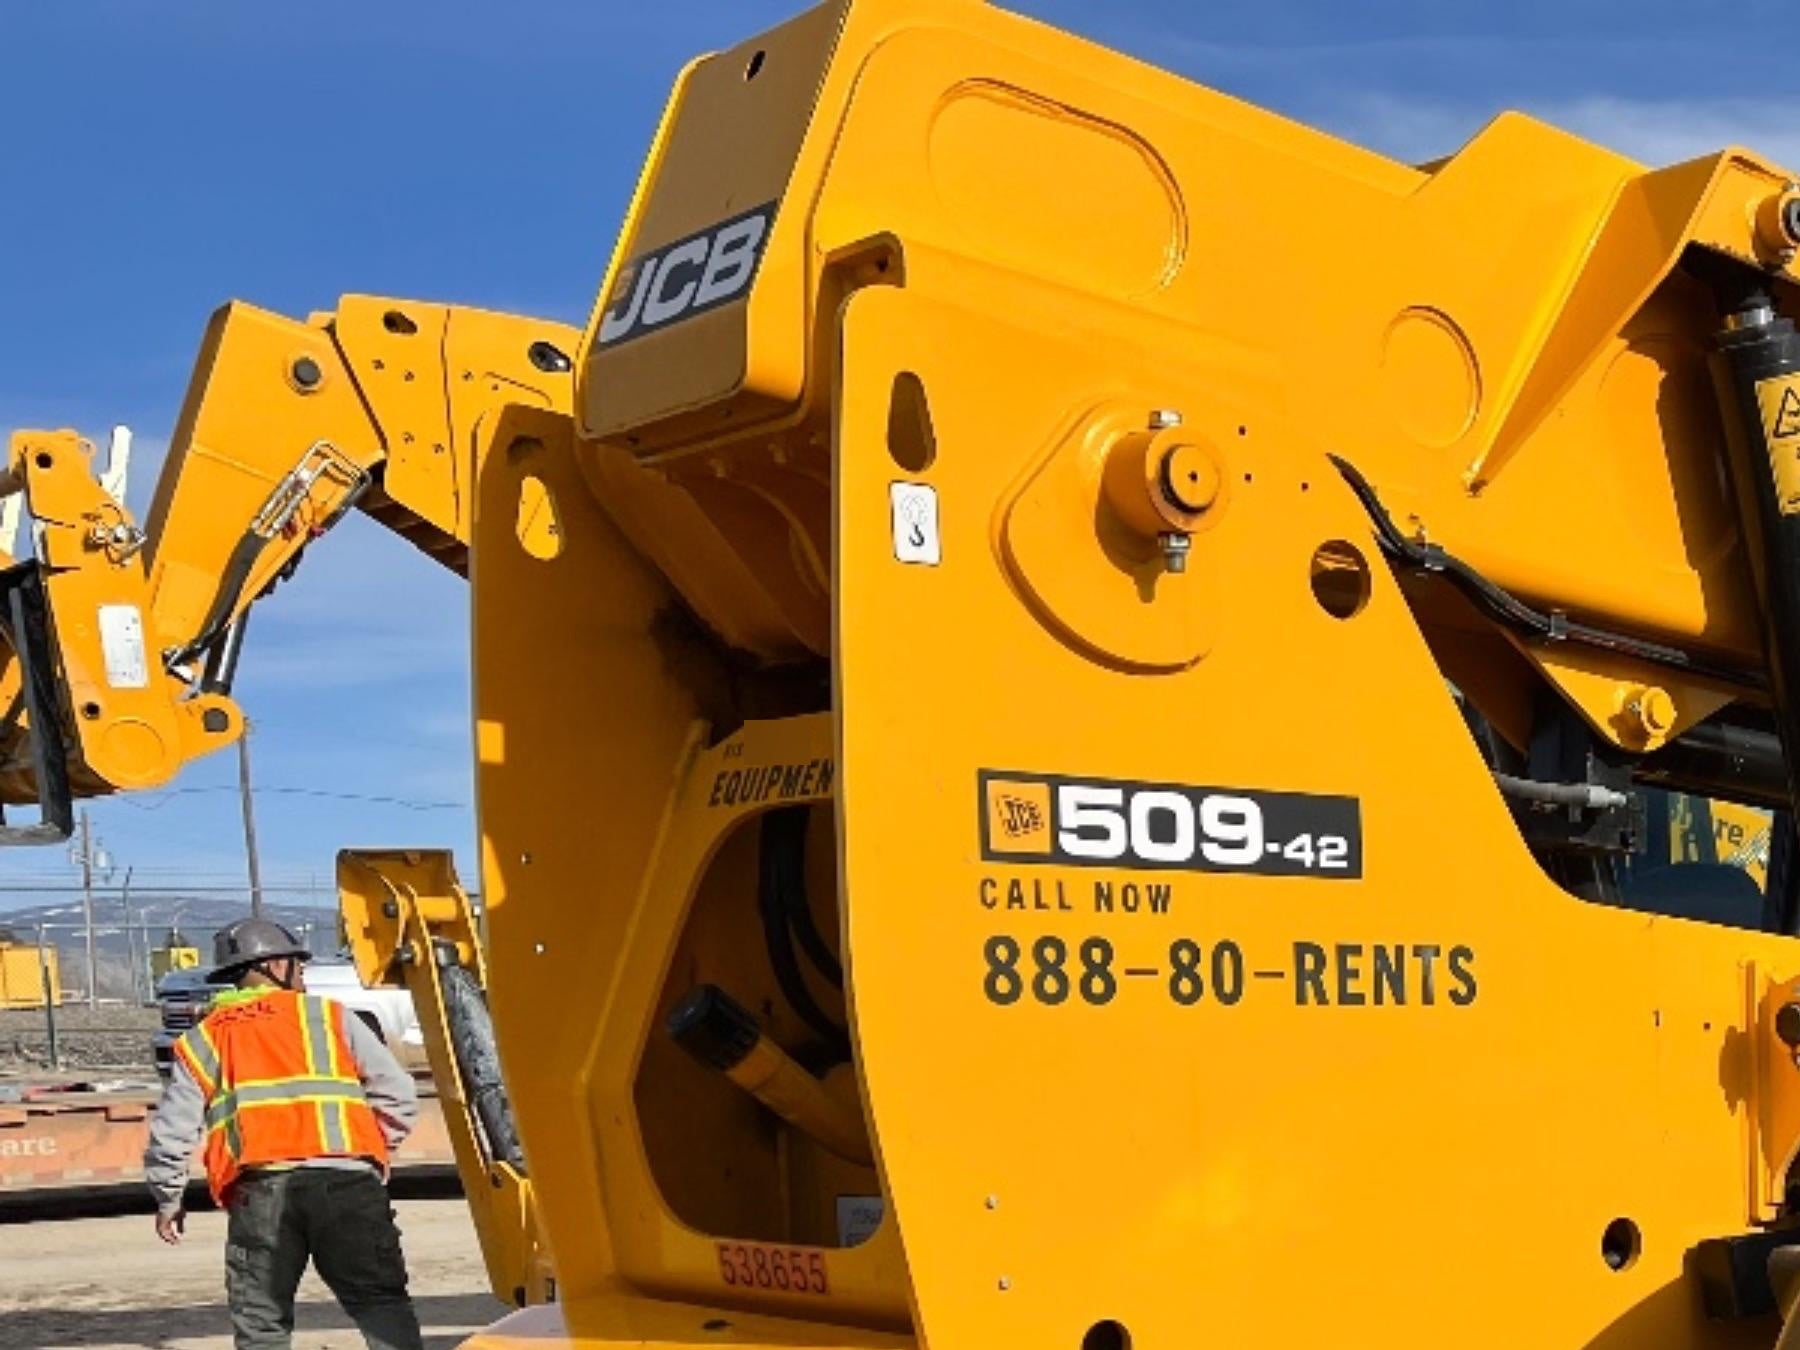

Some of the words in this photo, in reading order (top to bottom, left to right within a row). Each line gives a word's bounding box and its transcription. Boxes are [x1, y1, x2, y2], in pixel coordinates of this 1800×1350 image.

[598, 215, 766, 343] JCB
[1057, 784, 1349, 868] 509-42
[979, 877, 1074, 911] CALL
[1094, 881, 1171, 913] NOW
[982, 935, 1477, 1006] 888-80-RENTS
[718, 1245, 828, 1293] 538655
